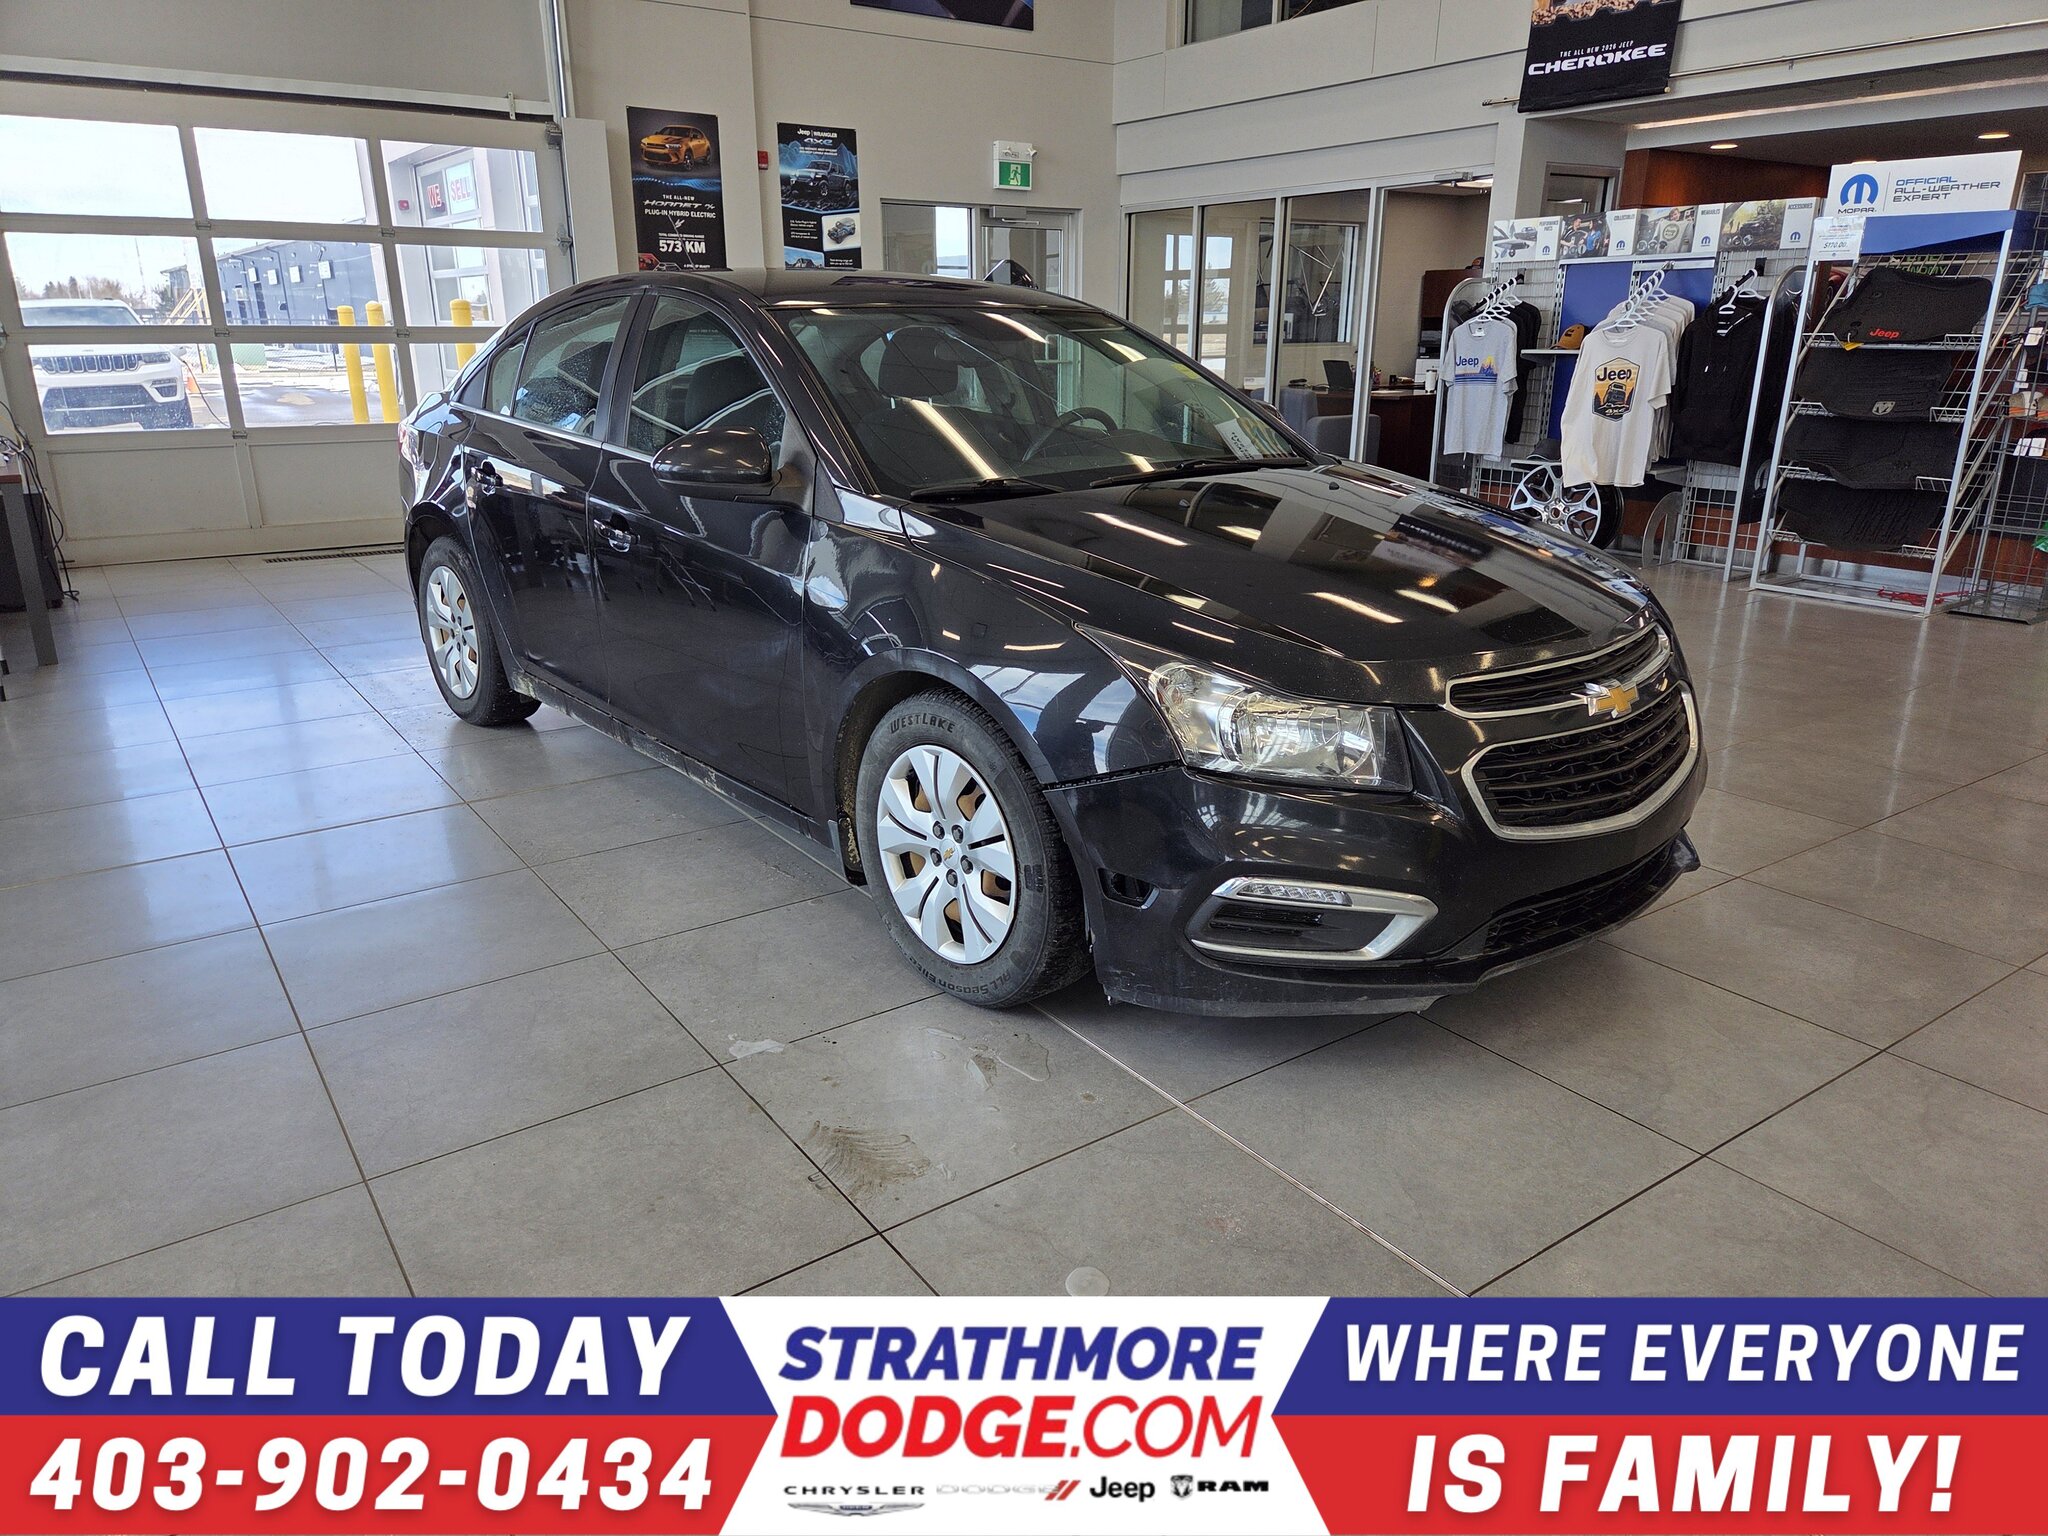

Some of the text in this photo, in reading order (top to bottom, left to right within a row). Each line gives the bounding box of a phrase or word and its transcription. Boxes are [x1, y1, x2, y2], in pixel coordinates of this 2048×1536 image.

[1560, 50, 1571, 58] THE
[1573, 48, 1584, 56] ALL
[1587, 46, 1600, 54] NEW
[1619, 40, 1634, 49] JEEP
[1527, 43, 1668, 76] CHEROKEE
[797, 128, 811, 136] Jeep
[1896, 176, 1958, 186] OFFICIAL
[427, 176, 472, 209] WE SELL
[1894, 181, 2001, 195] ALL-WEATHER
[1892, 192, 1951, 203] EXPERT
[643, 200, 702, 209] HORNET
[644, 208, 668, 216] PLUG-IN
[690, 211, 717, 219] ELECTRIC
[659, 240, 706, 254] 573 KM
[1869, 328, 1900, 339] Jeep
[1456, 355, 1480, 368] Jeep
[1597, 367, 1632, 382] Jeep
